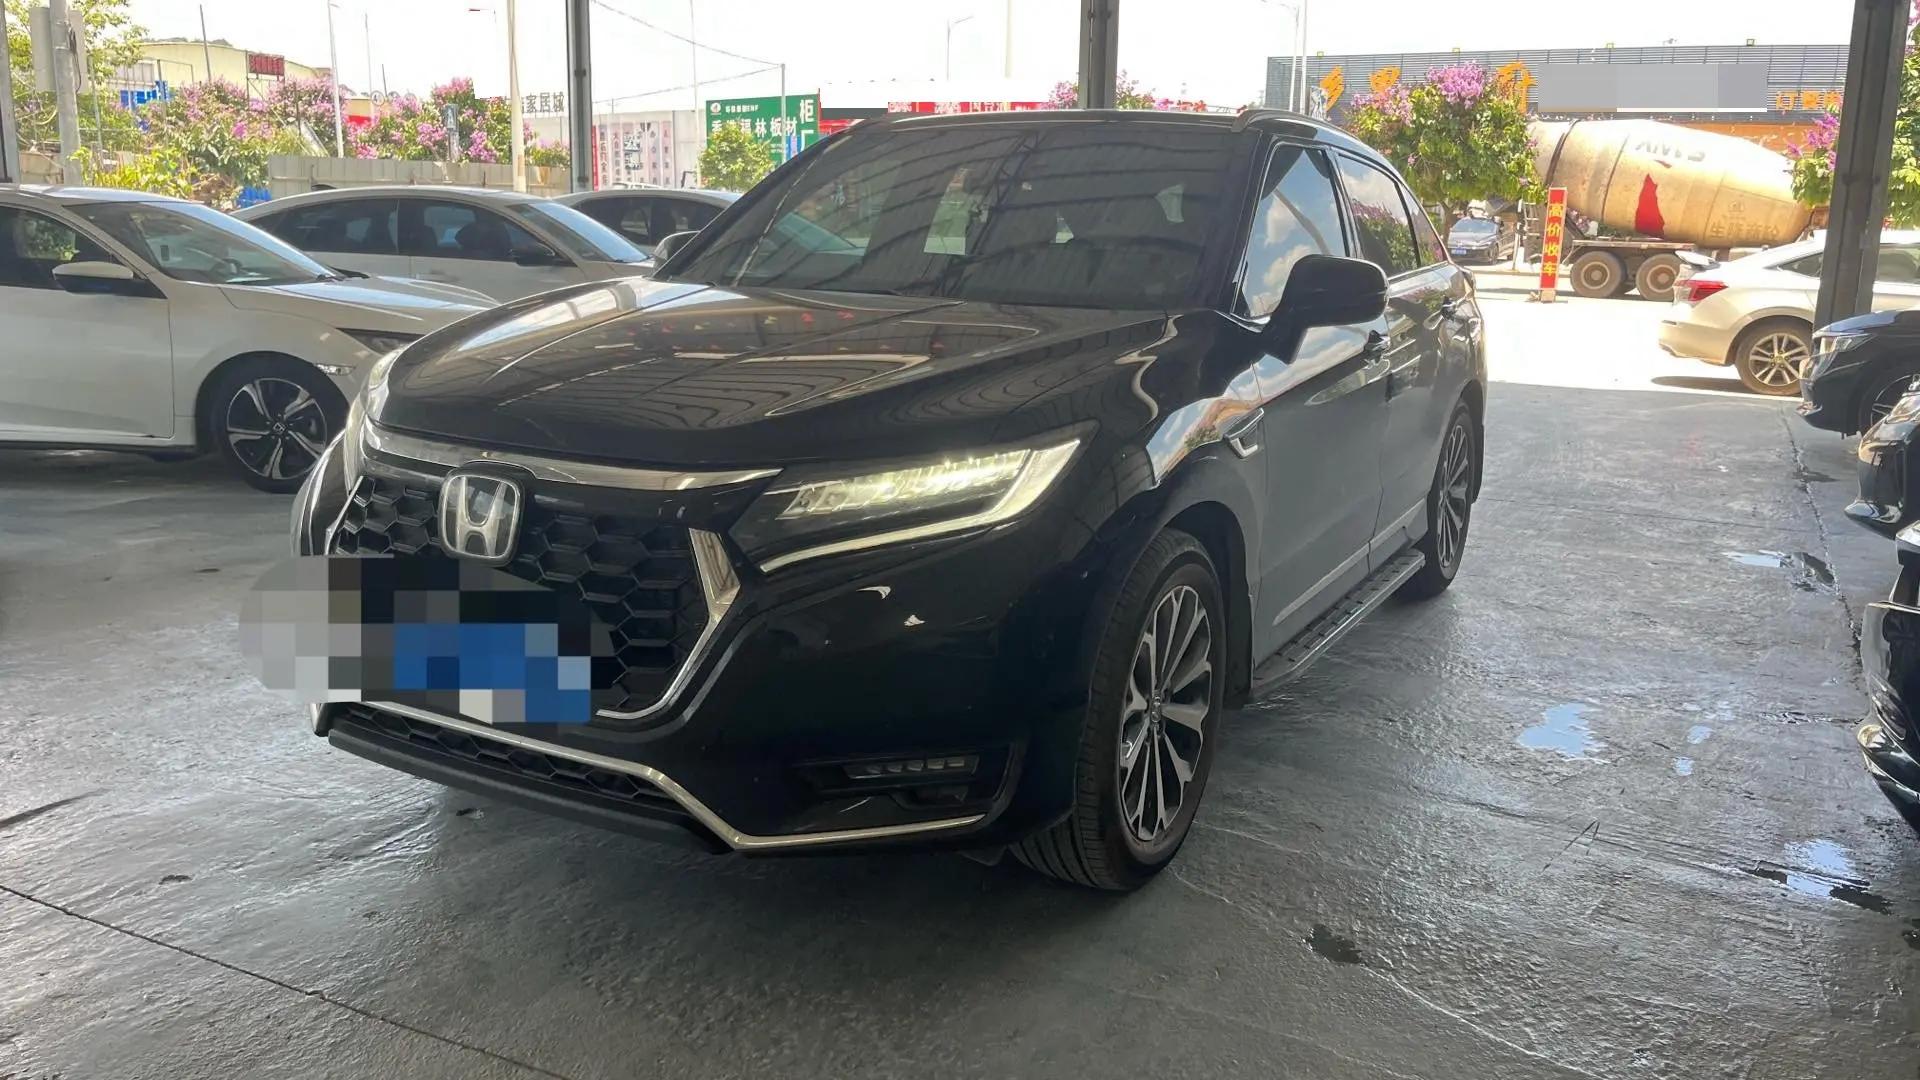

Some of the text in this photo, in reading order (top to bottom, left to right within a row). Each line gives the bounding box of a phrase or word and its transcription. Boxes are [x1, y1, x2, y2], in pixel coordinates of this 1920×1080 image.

[521, 92, 564, 113] 家居城
[711, 117, 797, 138] 香福林板材
[1543, 203, 1563, 276] 高价收车
